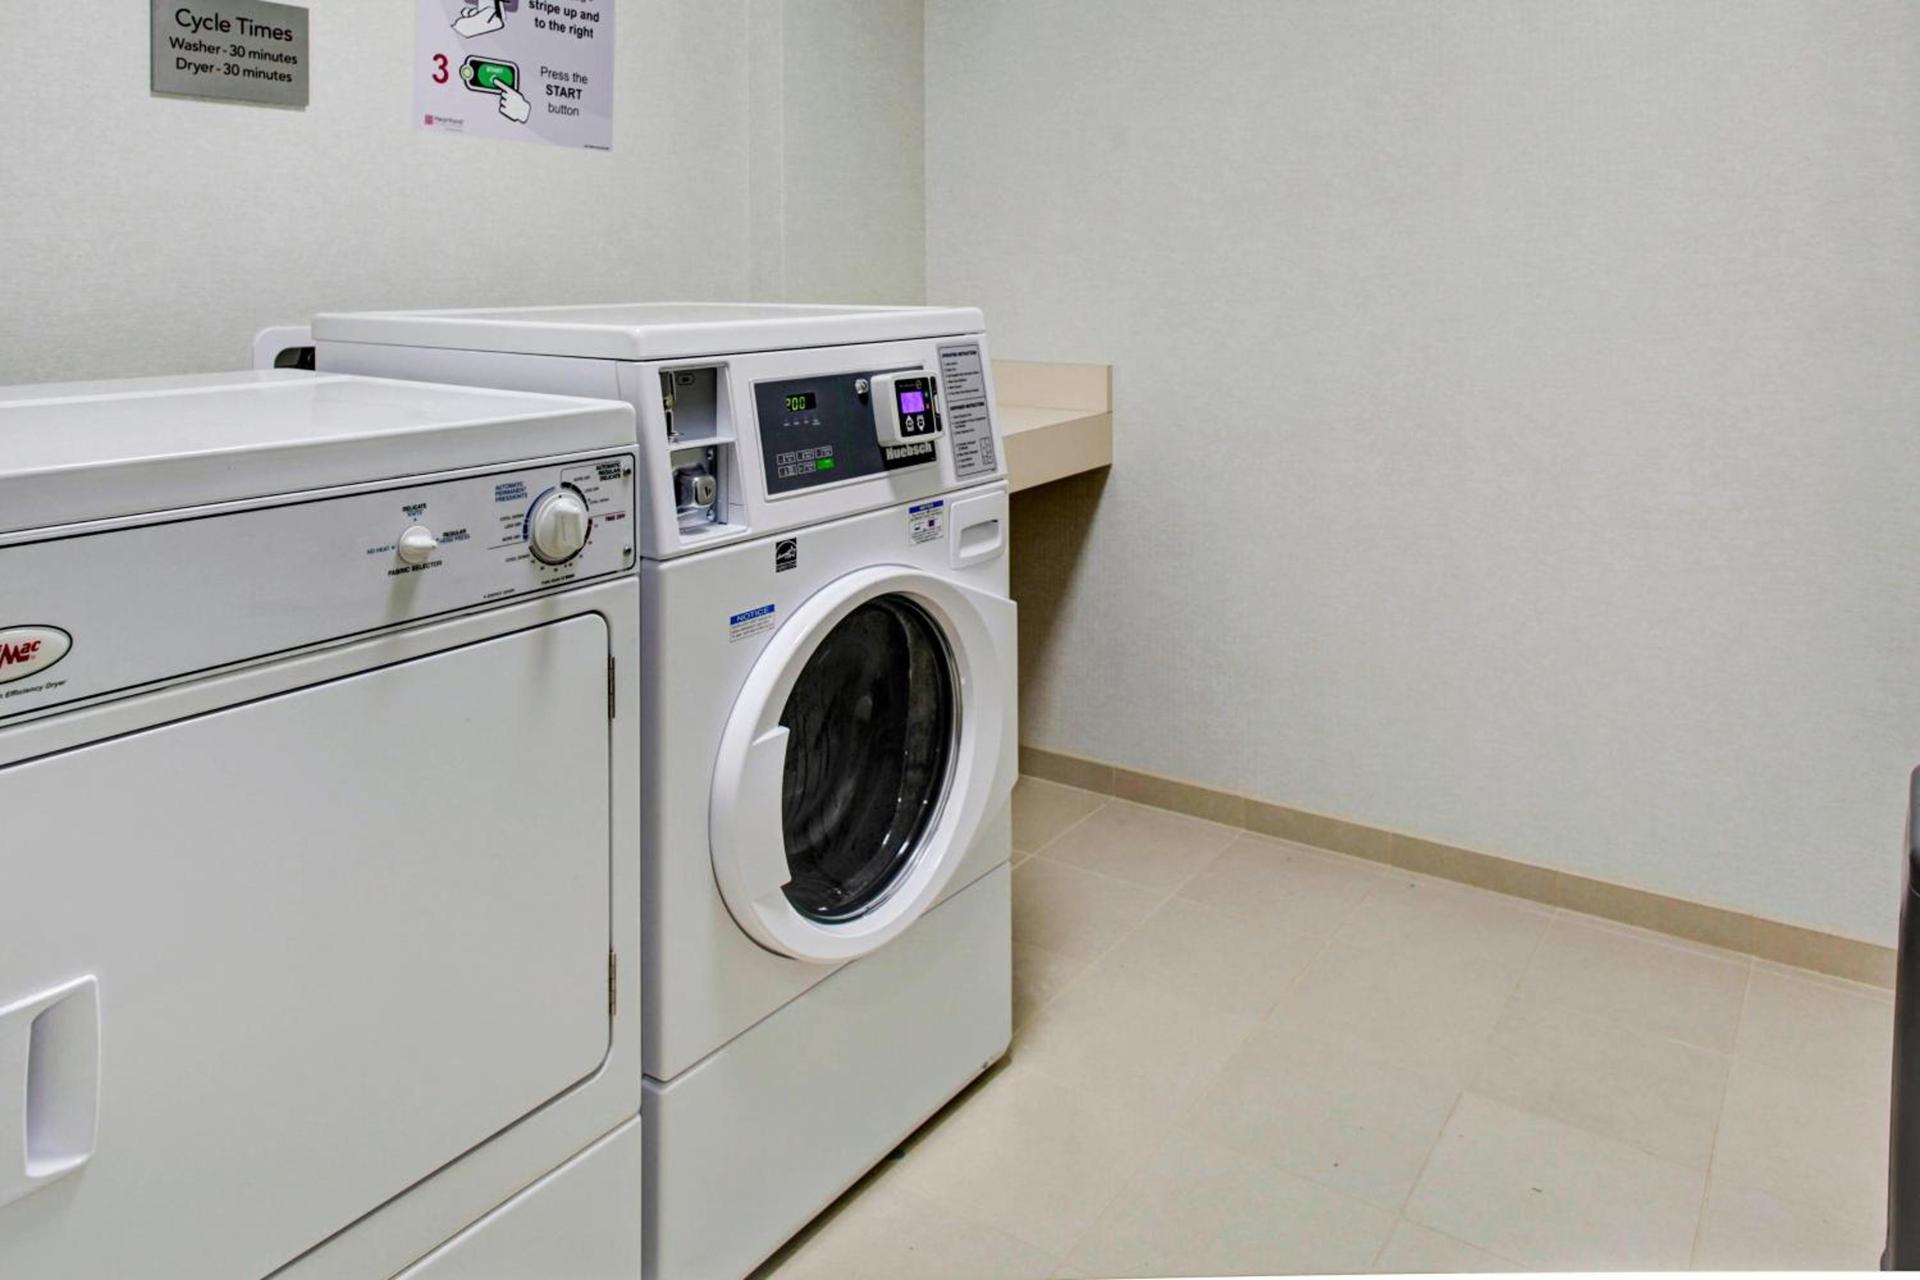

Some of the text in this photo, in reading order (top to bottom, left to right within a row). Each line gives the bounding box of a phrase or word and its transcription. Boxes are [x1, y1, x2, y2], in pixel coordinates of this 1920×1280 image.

[529, 0, 600, 23] stripe up and
[175, 8, 293, 42] Cycle Times
[534, 16, 594, 39] to the right
[169, 36, 221, 55] Washer
[229, 44, 245, 58] 30
[248, 48, 298, 65] minutes
[176, 57, 214, 75] Dryer
[223, 62, 240, 77] 30
[242, 66, 293, 83] minutes
[432, 53, 449, 84] 3
[540, 66, 589, 85] Press the
[546, 84, 583, 100] START
[548, 103, 580, 117] button
[886, 441, 932, 460] Huebsch
[736, 606, 769, 622] NOTICE
